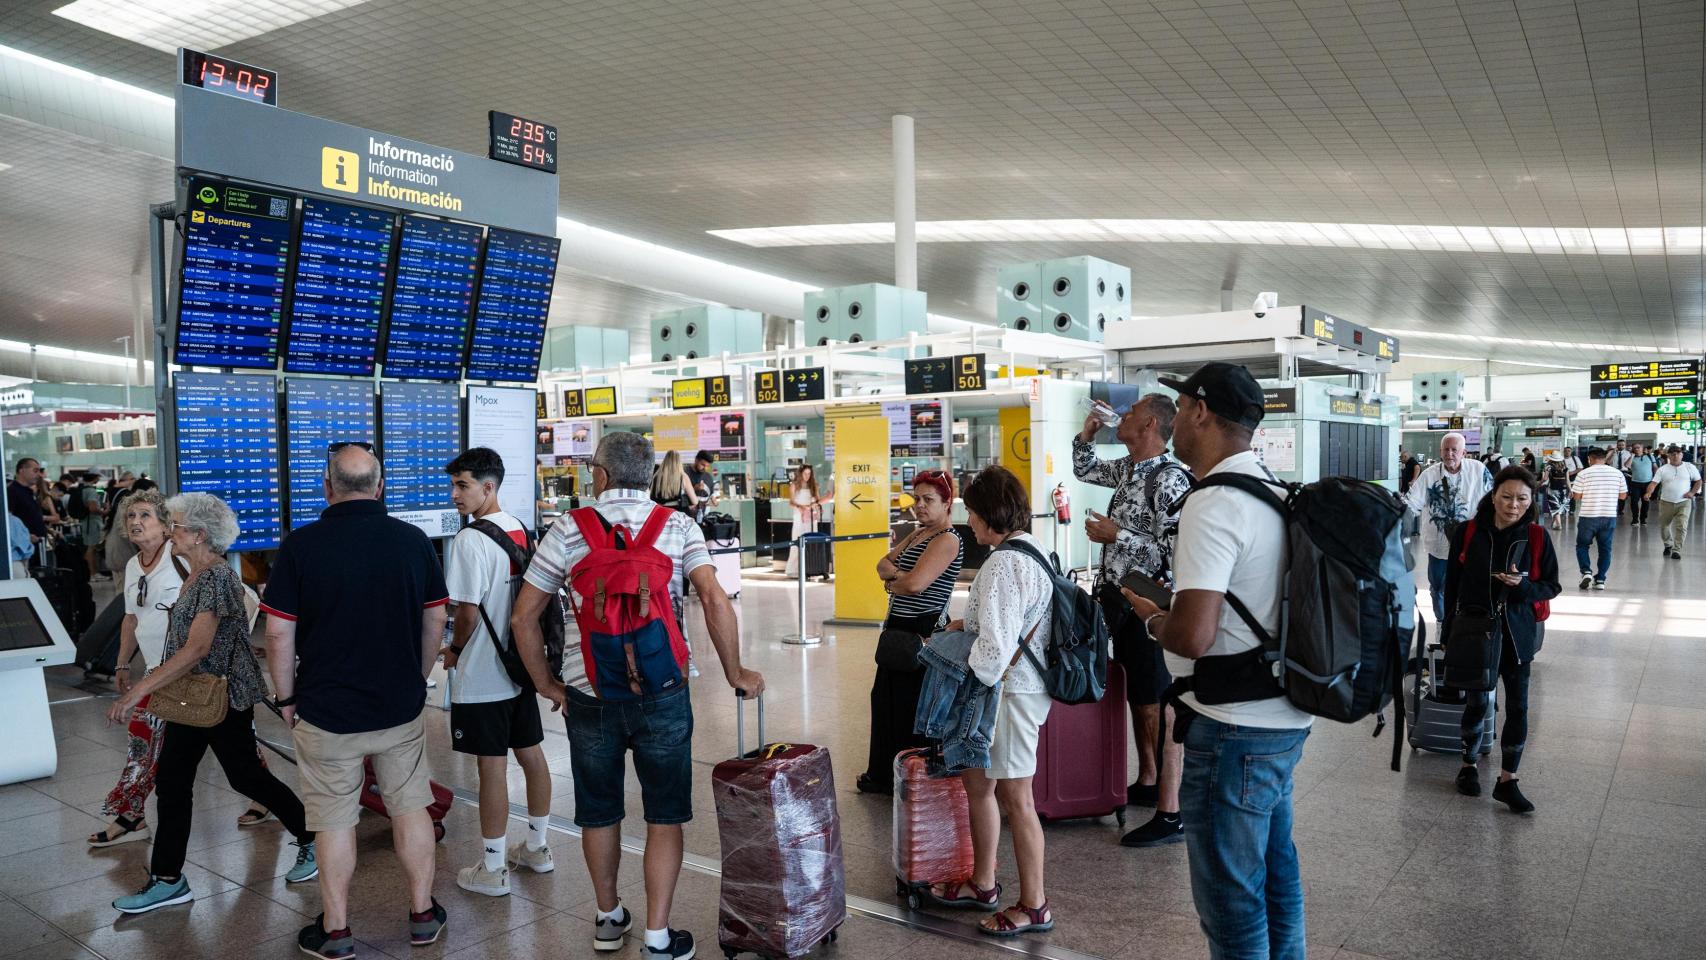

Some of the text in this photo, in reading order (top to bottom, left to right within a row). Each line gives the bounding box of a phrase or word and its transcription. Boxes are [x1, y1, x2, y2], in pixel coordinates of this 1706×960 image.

[200, 62, 270, 97] 13:02
[369, 136, 455, 172] Informació
[523, 144, 544, 164] 54
[368, 158, 438, 187] Information
[368, 177, 462, 212] Información
[208, 215, 251, 229] Departures
[959, 376, 982, 389] 501
[676, 388, 700, 398] vueling
[758, 390, 778, 402] 502
[475, 395, 498, 406] Mpox
[710, 394, 728, 405] 503
[566, 407, 582, 416] 504
[852, 464, 871, 472] EXIT
[846, 476, 877, 484] SALIDA
